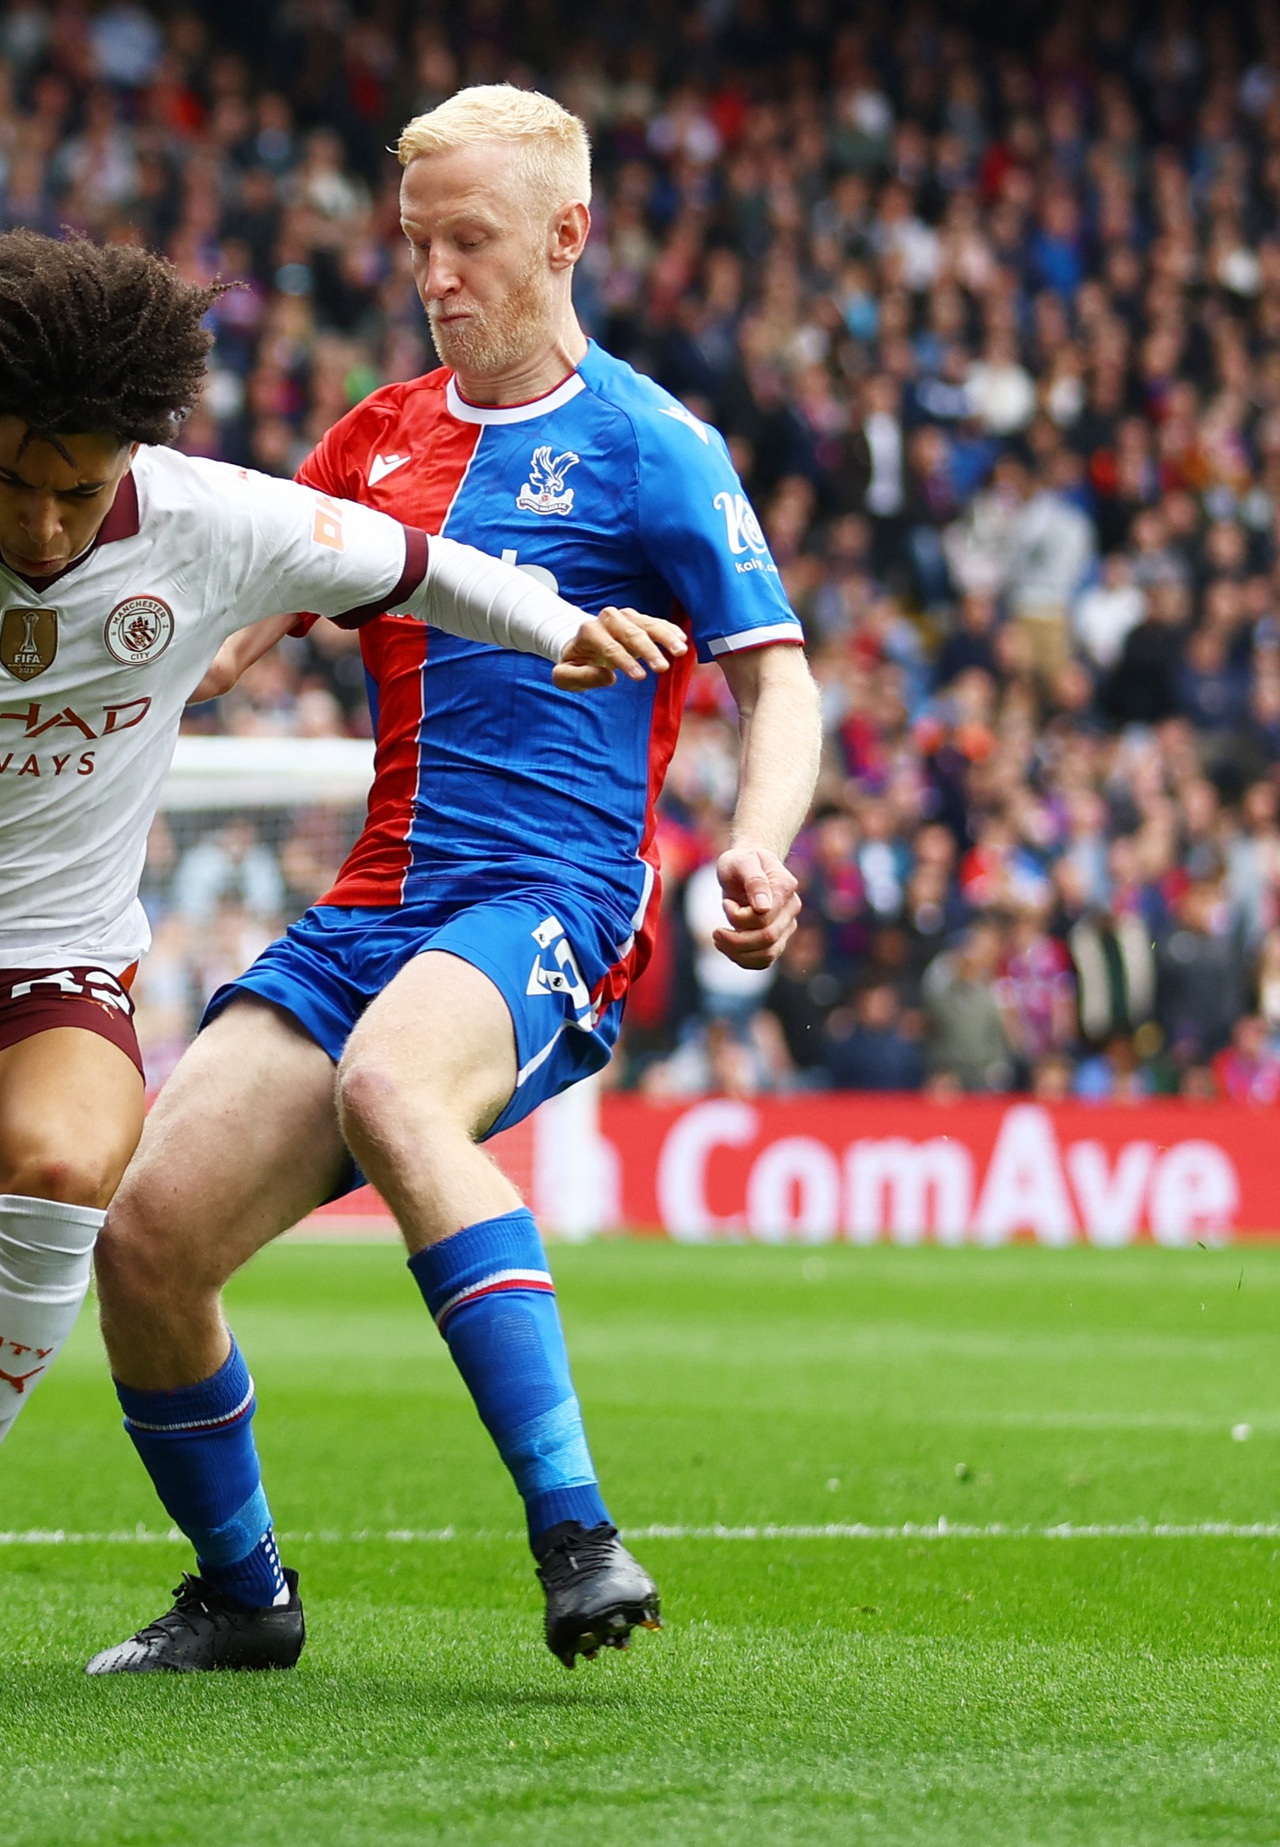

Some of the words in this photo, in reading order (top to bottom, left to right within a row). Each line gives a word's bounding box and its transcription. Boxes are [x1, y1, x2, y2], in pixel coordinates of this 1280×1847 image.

[113, 600, 166, 624] MANCHESTER
[14, 654, 41, 664] FIFA
[130, 651, 150, 660] CITY
[657, 1100, 1238, 1247] ComAve
